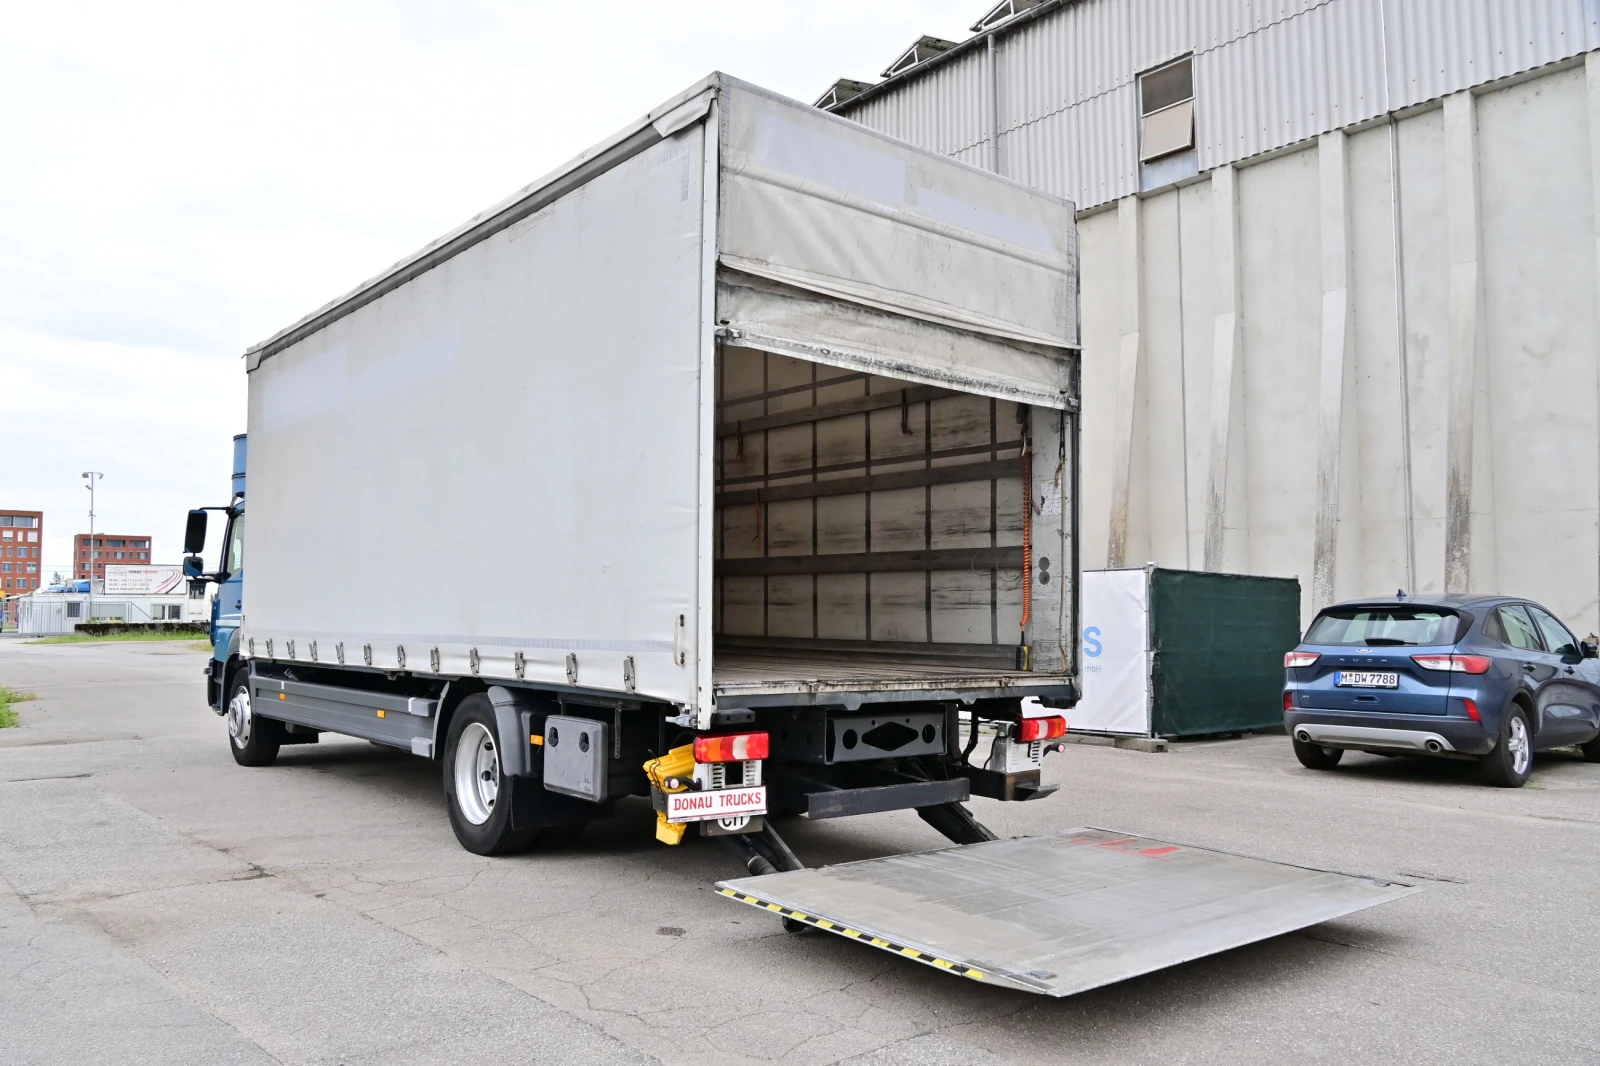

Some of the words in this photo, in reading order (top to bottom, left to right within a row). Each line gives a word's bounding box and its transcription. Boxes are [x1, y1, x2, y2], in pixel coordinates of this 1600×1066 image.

[1354, 673, 1368, 683] DW
[1369, 674, 1396, 685] 7788
[674, 796, 712, 811] DONAU
[719, 792, 761, 807] TRUCKS
